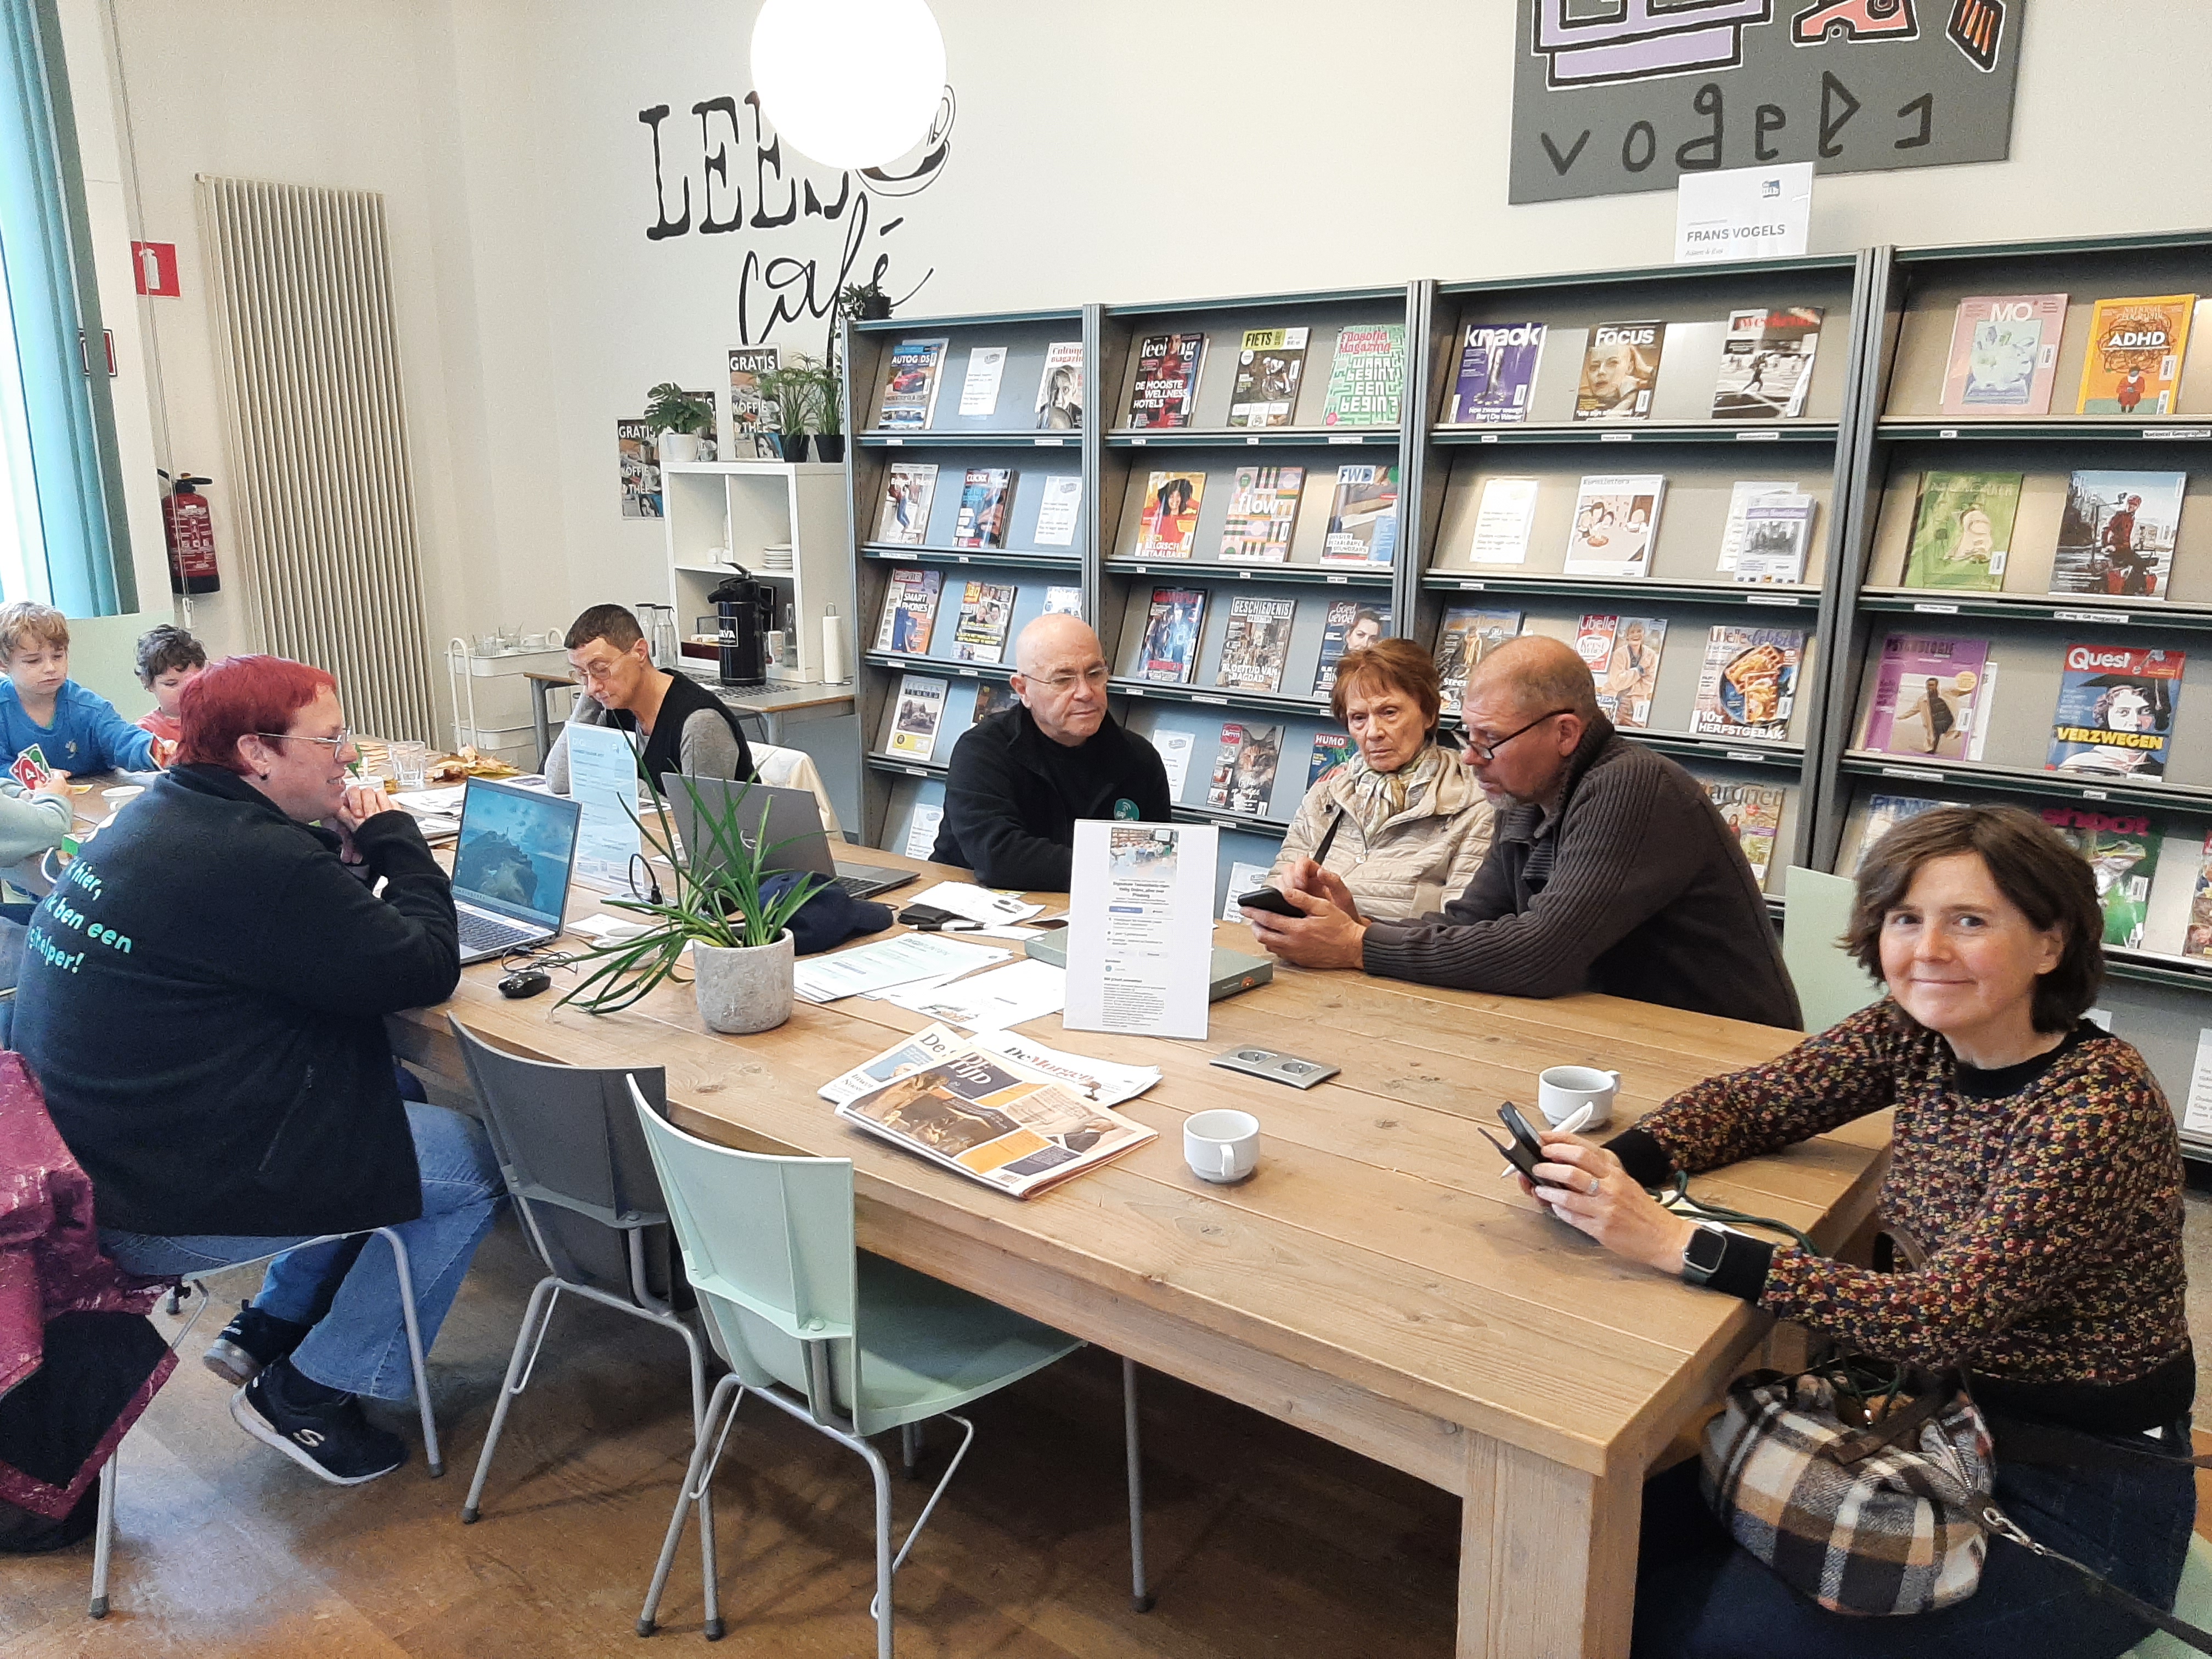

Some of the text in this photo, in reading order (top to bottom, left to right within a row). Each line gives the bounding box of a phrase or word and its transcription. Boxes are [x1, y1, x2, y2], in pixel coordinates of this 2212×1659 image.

[1687, 224, 1785, 242] FRANS VOGELS
[1246, 332, 1273, 347] FIETS
[1595, 328, 1655, 348] FOCUS
[2108, 331, 2165, 347] ADHD
[1141, 336, 1197, 361] feelng
[730, 356, 775, 370] GRATIS
[891, 354, 931, 364] AUTOGIDS
[1135, 380, 1183, 391] DE MOOISTE
[1144, 389, 1188, 398] WELLNESS
[733, 400, 768, 413] KOFFIE
[1133, 399, 1164, 409] HOTELS
[1341, 468, 1373, 482] FWD
[904, 593, 927, 602] SMART
[1234, 600, 1290, 616] GESCHIEDENIS
[2068, 648, 2131, 669] Quest
[1701, 712, 1724, 723] 10x
[1316, 735, 1344, 746] HUMO
[2057, 727, 2164, 750] VERZWEGEN
[53, 898, 84, 929] ben
[87, 923, 132, 953] een
[919, 1033, 946, 1053] De
